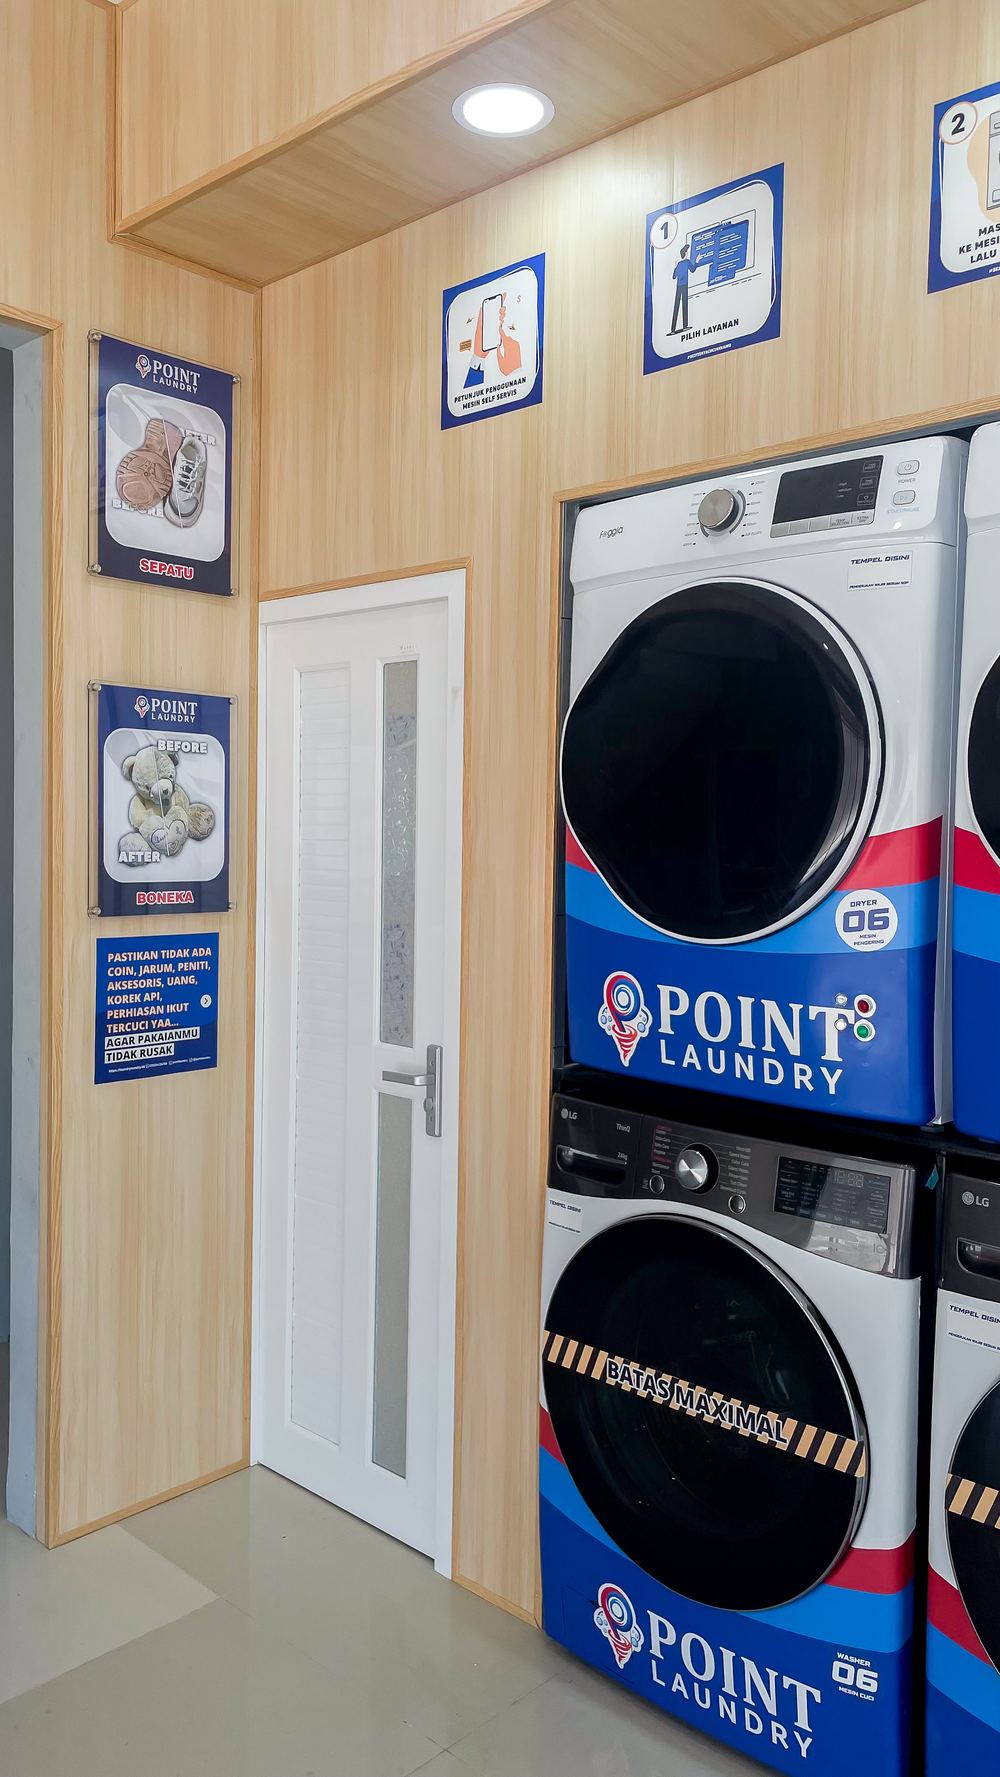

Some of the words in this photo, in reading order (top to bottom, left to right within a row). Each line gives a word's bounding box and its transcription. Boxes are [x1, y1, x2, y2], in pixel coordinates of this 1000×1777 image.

[951, 112, 966, 135] 2
[660, 221, 669, 240] 1
[958, 244, 972, 255] KE
[970, 249, 997, 263] LALU
[680, 330, 701, 342] PILIH
[702, 318, 740, 336] LAYANAN
[152, 358, 201, 386] POINT
[153, 376, 198, 394] LAUNDRY
[454, 389, 485, 403] PETUNJUK
[485, 376, 527, 395] PENGGUNAAN
[462, 400, 481, 410] MESIN
[481, 395, 495, 405] SELF
[496, 388, 517, 401] SERVIS
[850, 557, 883, 565] TEMPEL
[885, 554, 910, 562] DISINI
[139, 558, 194, 580] SEPATU
[151, 698, 198, 716] POINT
[151, 712, 196, 724] LAUNDRY
[157, 739, 208, 754] BEFORE
[118, 851, 161, 864] AFTER
[136, 890, 194, 905] BONEKA
[849, 899, 878, 908] DRYER
[842, 907, 890, 933] 06
[107, 950, 158, 963] PASTIKAN
[160, 948, 190, 959] TIDAK
[191, 947, 212, 957] ADA
[107, 966, 137, 977] COIN,
[138, 963, 175, 977] JARUM,
[177, 960, 211, 972] PENITI,
[107, 977, 164, 991] AKSESORIS,
[167, 975, 198, 986] UANG,
[107, 993, 141, 1005] KOREK
[143, 991, 163, 1002] API,
[107, 1004, 164, 1019] PERHIASAN
[166, 1002, 189, 1013] IKUT
[106, 1020, 149, 1034] TERCUCI
[150, 1018, 179, 1029] YAA...
[656, 984, 855, 1062] POINT
[106, 1036, 135, 1048] AGAR
[138, 1029, 198, 1044] PAKAIANMU
[106, 1050, 138, 1062] TIDAK
[140, 1045, 173, 1059] RUSAK
[660, 1039, 843, 1095] LAUNDRY
[568, 1111, 578, 1120] LG
[616, 1123, 631, 1133] ThinQ
[975, 1195, 990, 1208] LG
[949, 1304, 979, 1319] TEMPEL
[606, 1358, 670, 1401] BATAS
[674, 1382, 789, 1444] MAXIMAL
[836, 1651, 871, 1667] WASHER
[646, 1609, 822, 1733] POINT
[831, 1660, 879, 1693] 06
[838, 1686, 859, 1697] MESIN
[859, 1692, 875, 1702] CUCI
[651, 1659, 813, 1758] LAUNDRY
